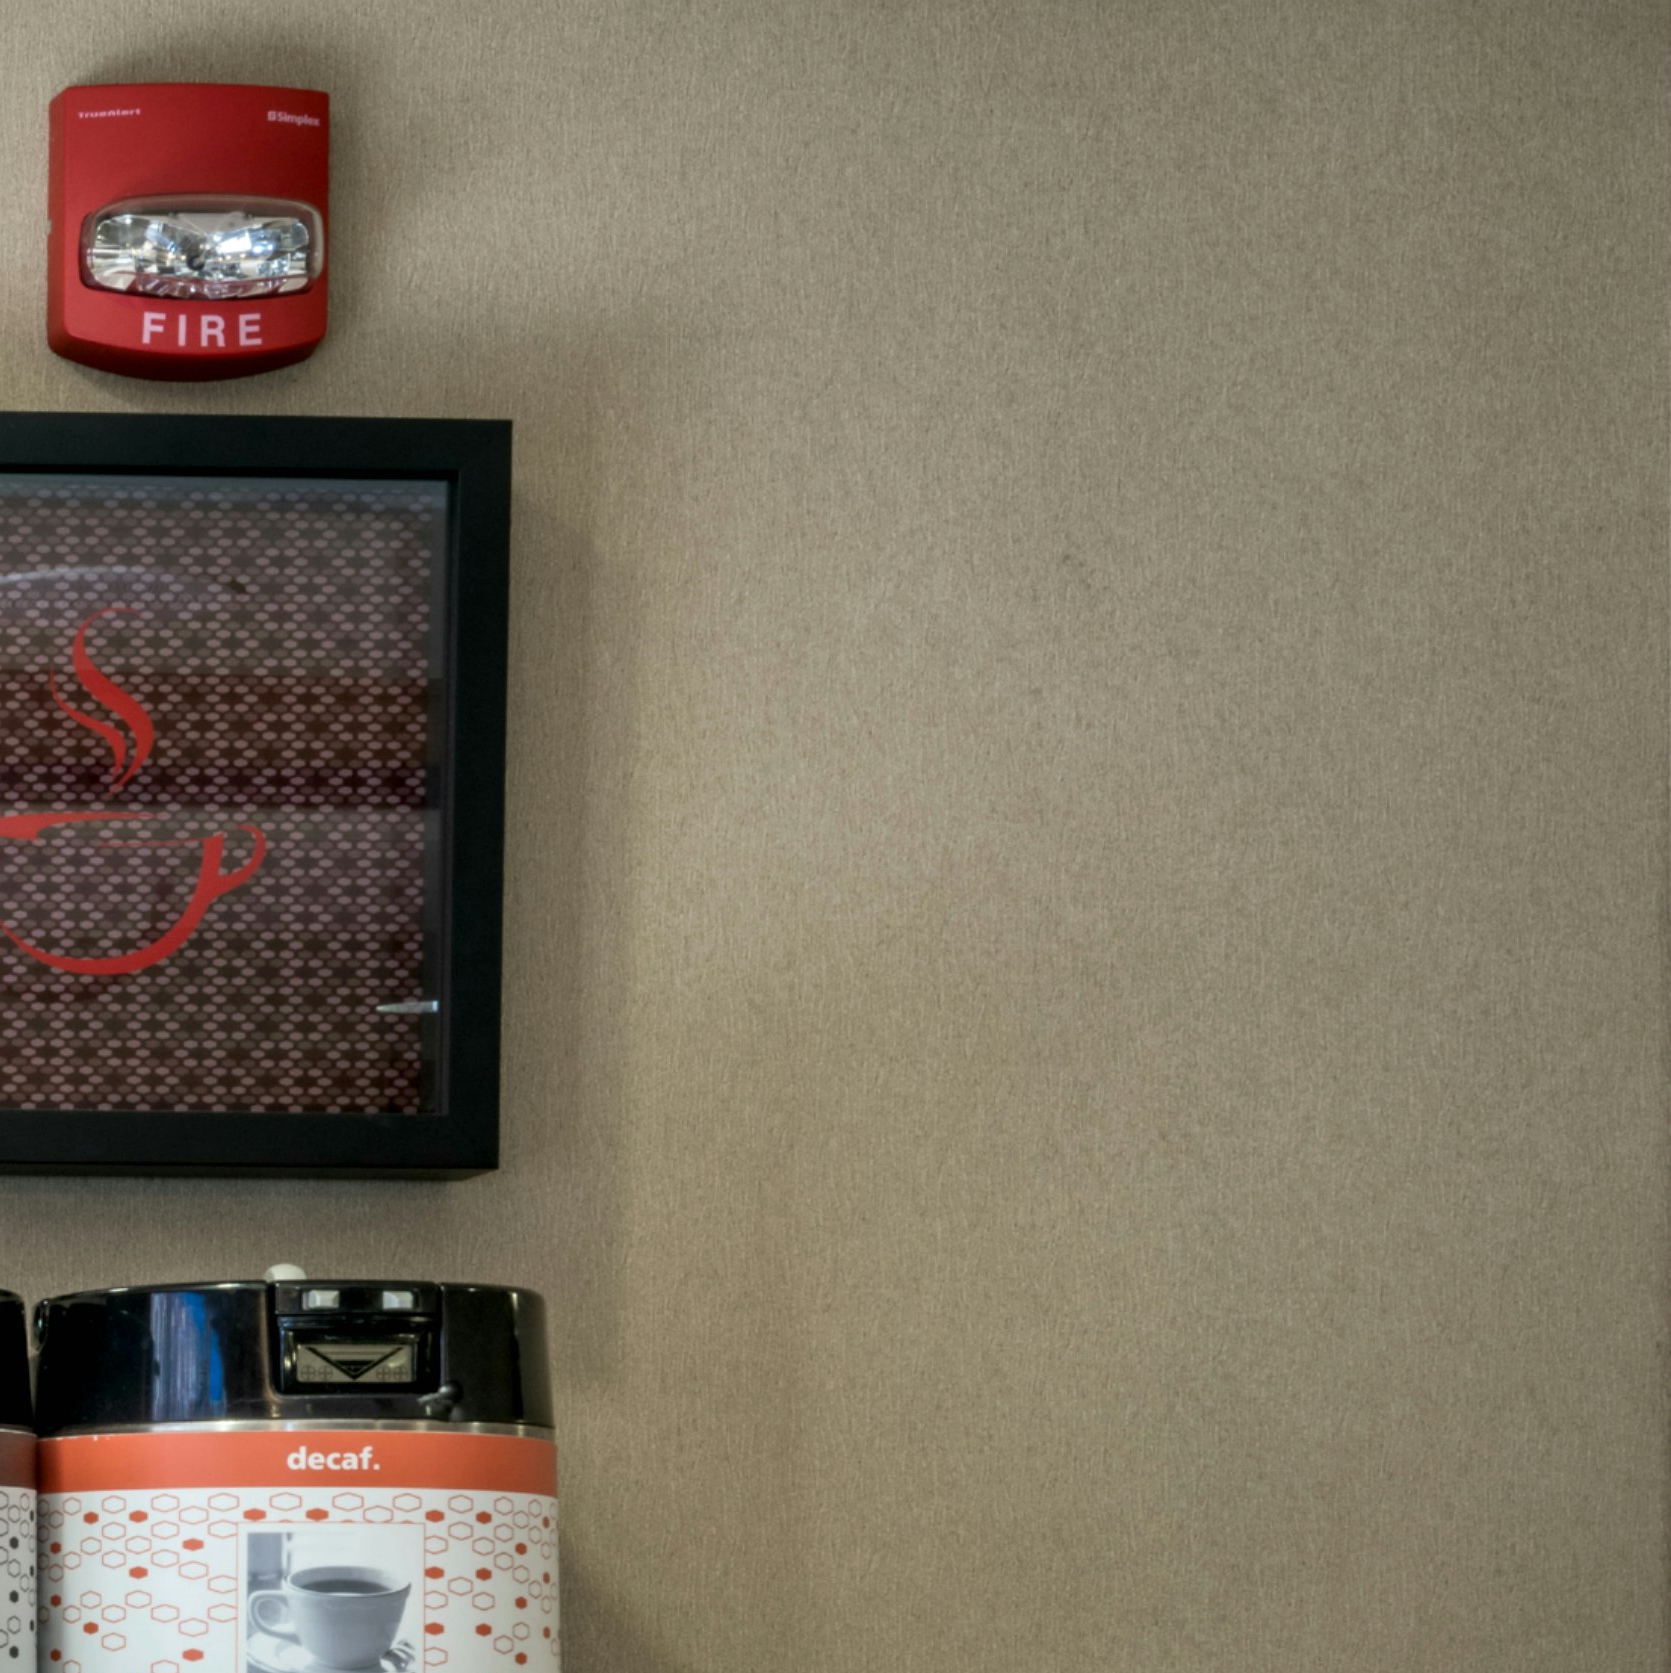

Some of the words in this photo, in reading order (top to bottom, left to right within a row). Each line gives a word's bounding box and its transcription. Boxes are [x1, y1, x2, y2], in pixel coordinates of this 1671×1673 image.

[78, 108, 141, 119] TrueAlert
[278, 111, 320, 127] Simplex
[142, 312, 262, 347] FIRE
[287, 1445, 380, 1471] decaf.
